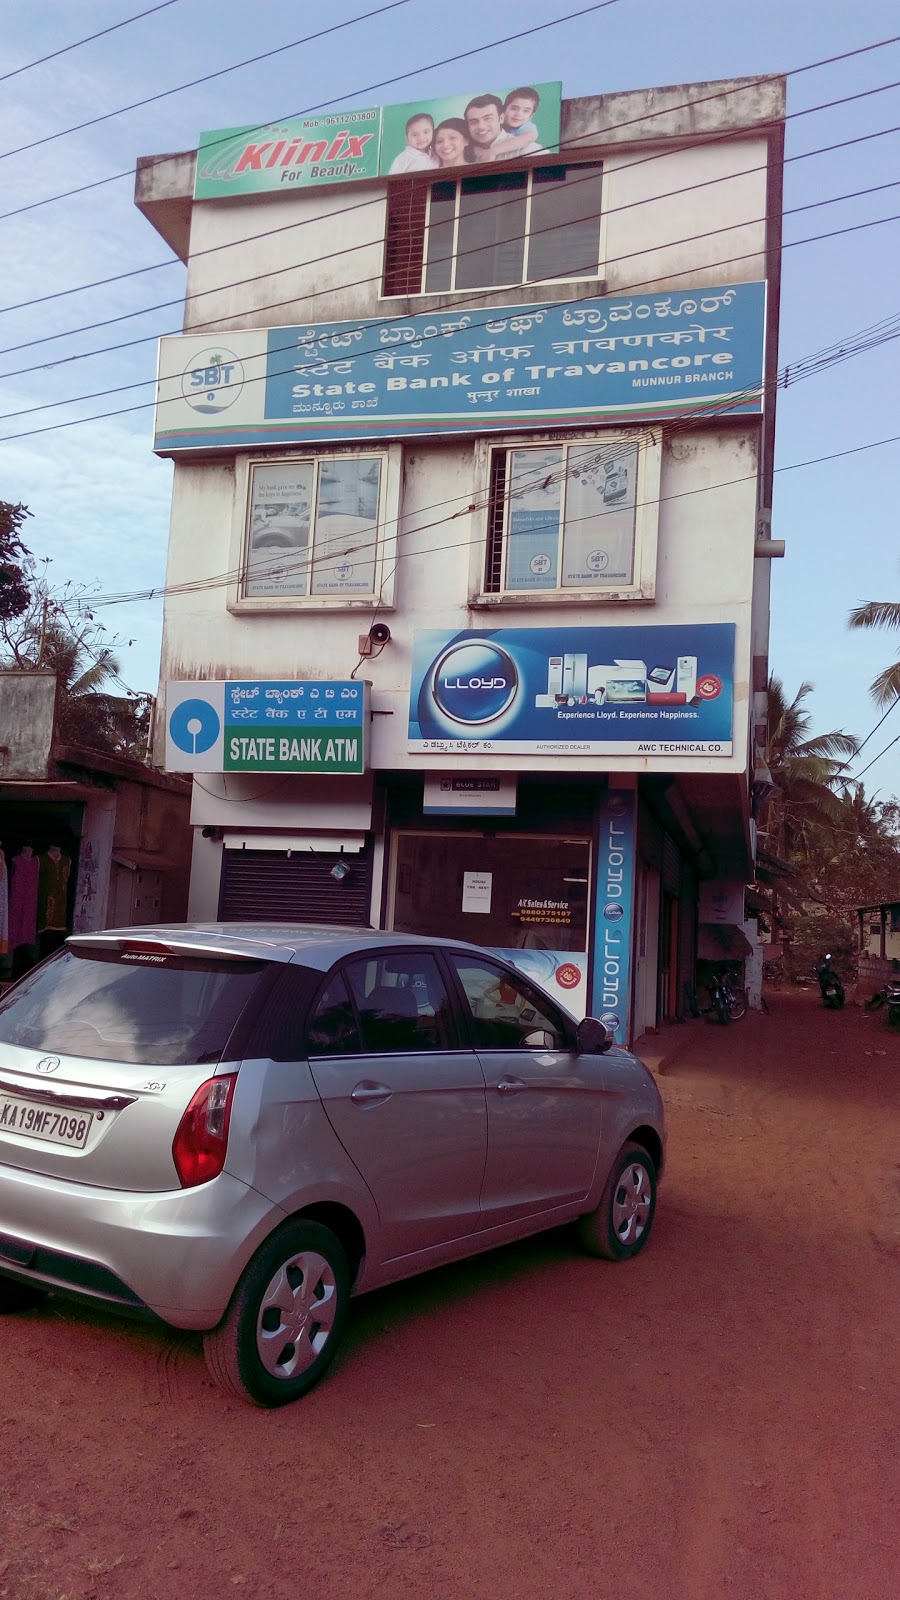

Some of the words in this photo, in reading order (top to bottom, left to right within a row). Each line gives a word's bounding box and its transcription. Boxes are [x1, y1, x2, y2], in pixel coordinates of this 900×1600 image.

[325, 116, 349, 126] 96112
[351, 112, 376, 122] 03800
[234, 131, 374, 173] Klinix
[281, 170, 302, 182] For
[297, 325, 366, 357] ಸ್ಟೇಟ್
[380, 316, 471, 348] ಬ್ಯಾಂಕ್
[293, 358, 356, 377] स्टेट
[373, 352, 432, 370] बैंक
[552, 324, 734, 355] त्रावणकोर
[191, 365, 234, 386] SBT
[291, 381, 376, 398] State
[387, 373, 472, 391] Bank
[481, 367, 515, 384] of
[525, 352, 734, 380] Travancore
[632, 375, 681, 388] MUNNUR
[685, 371, 733, 383] BRANCH
[506, 386, 541, 397] शाखा
[444, 677, 506, 689] LLOYD
[231, 687, 260, 704] ಸ್ಟೇಟ್
[265, 687, 304, 704] ಬ್ಯಾಂಕ್
[231, 707, 259, 719] स्टेट
[265, 707, 289, 719] बैंक
[297, 709, 307, 719] ए
[314, 707, 327, 719] टी
[335, 709, 357, 719] एम
[557, 711, 595, 720] Experience
[596, 711, 618, 720] Lloyd.
[619, 711, 659, 720] Experience
[659, 711, 699, 720] Happiness.
[230, 738, 275, 761] STATE
[279, 738, 322, 761] BANK
[324, 739, 357, 761] ATM
[638, 744, 657, 752] AWC
[659, 744, 706, 752] TECHNICAL
[708, 744, 723, 752] CO.
[607, 821, 624, 898] LLOYD
[603, 928, 621, 1008] LLOYD
[0, 1104, 87, 1141] KA19MF7098
